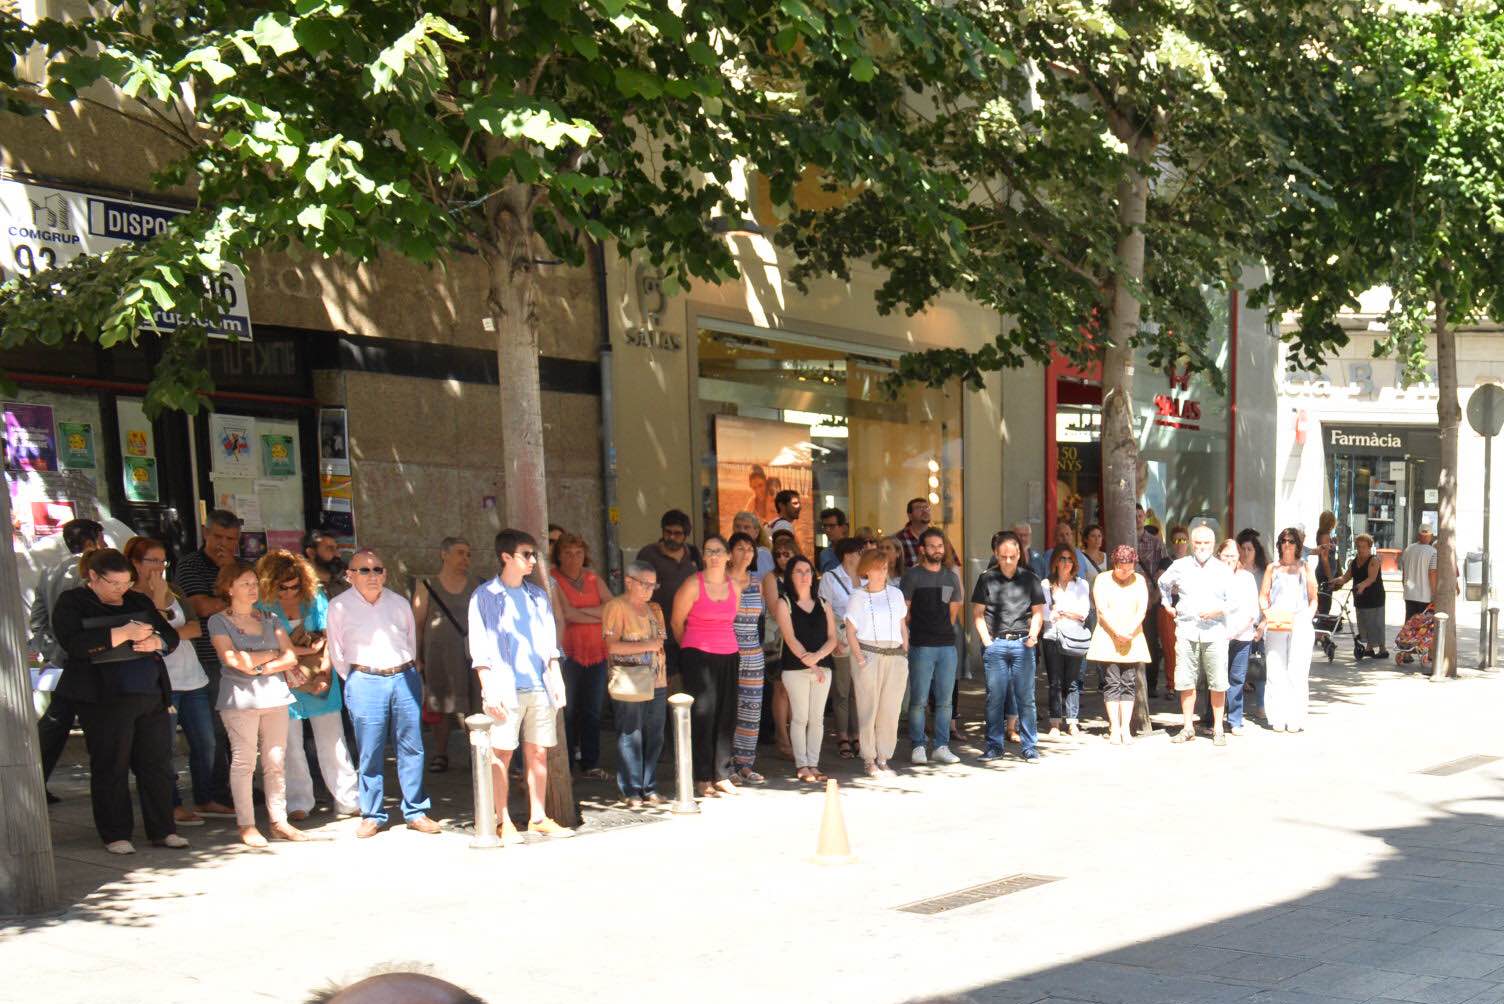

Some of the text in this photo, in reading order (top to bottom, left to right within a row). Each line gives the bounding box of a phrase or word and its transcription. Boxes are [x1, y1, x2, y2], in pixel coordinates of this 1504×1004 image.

[108, 209, 167, 236] DISPO
[8, 226, 80, 244] COMGRUP
[1330, 429, 1402, 449] Farmàcia
